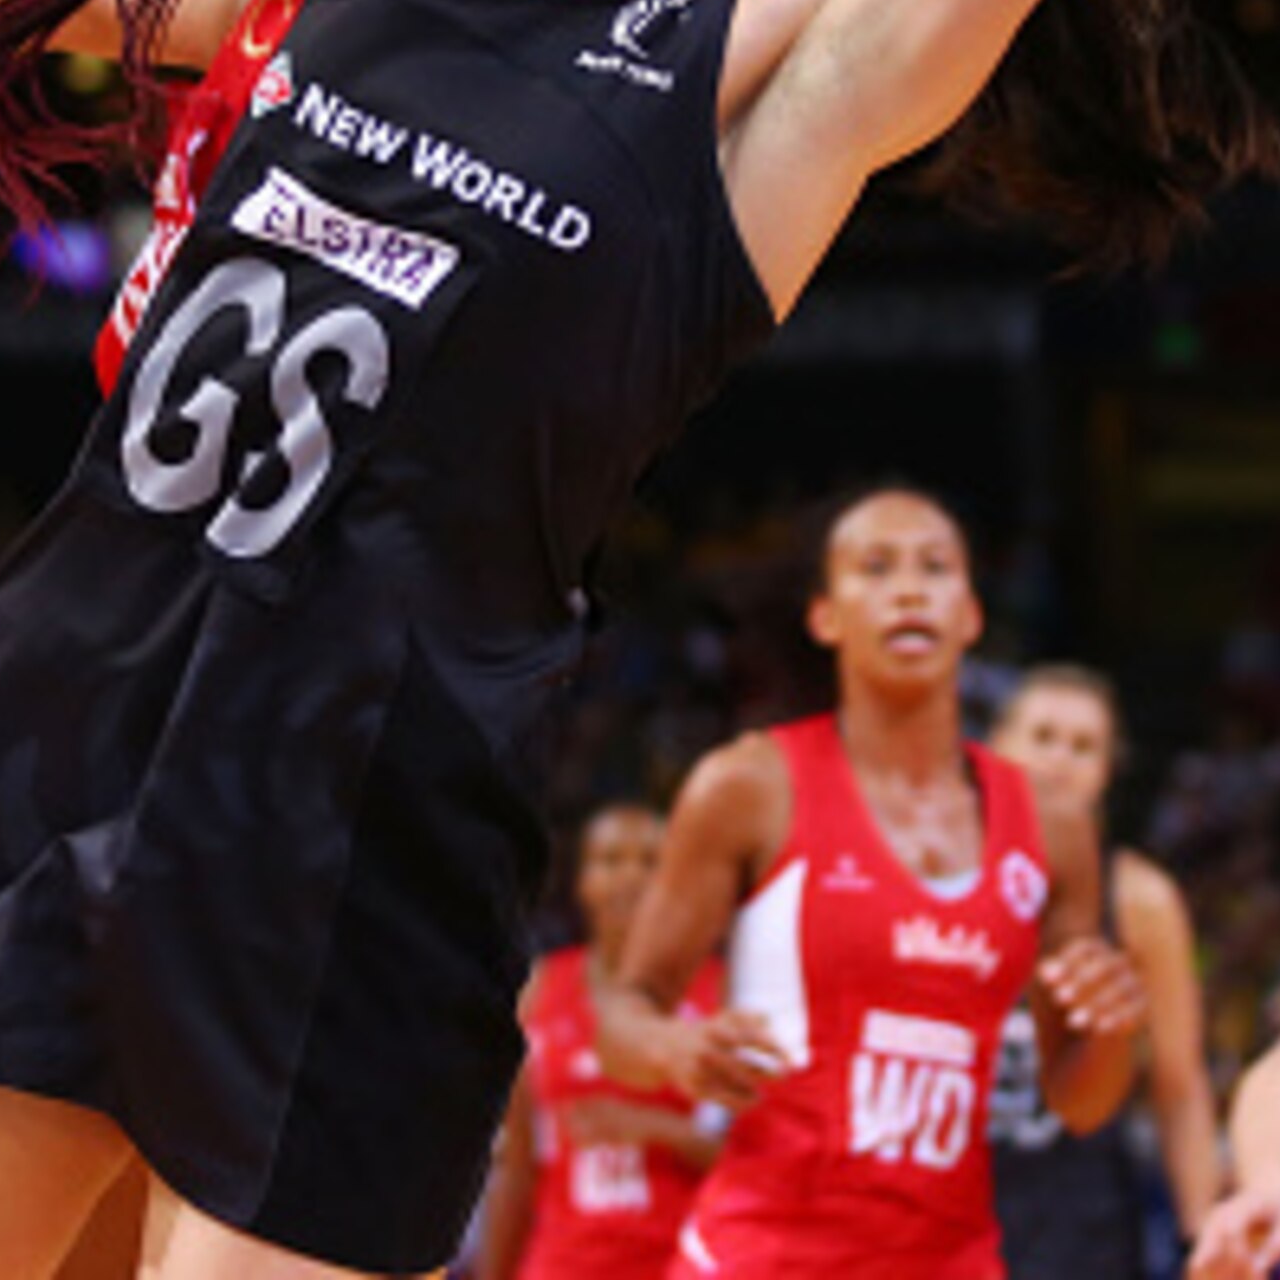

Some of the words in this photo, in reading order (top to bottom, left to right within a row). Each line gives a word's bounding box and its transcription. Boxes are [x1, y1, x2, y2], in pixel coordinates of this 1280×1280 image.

[293, 82, 409, 163] NEW
[412, 133, 591, 250] WORLD
[122, 258, 389, 558] GS
[849, 1054, 976, 1170] WD
